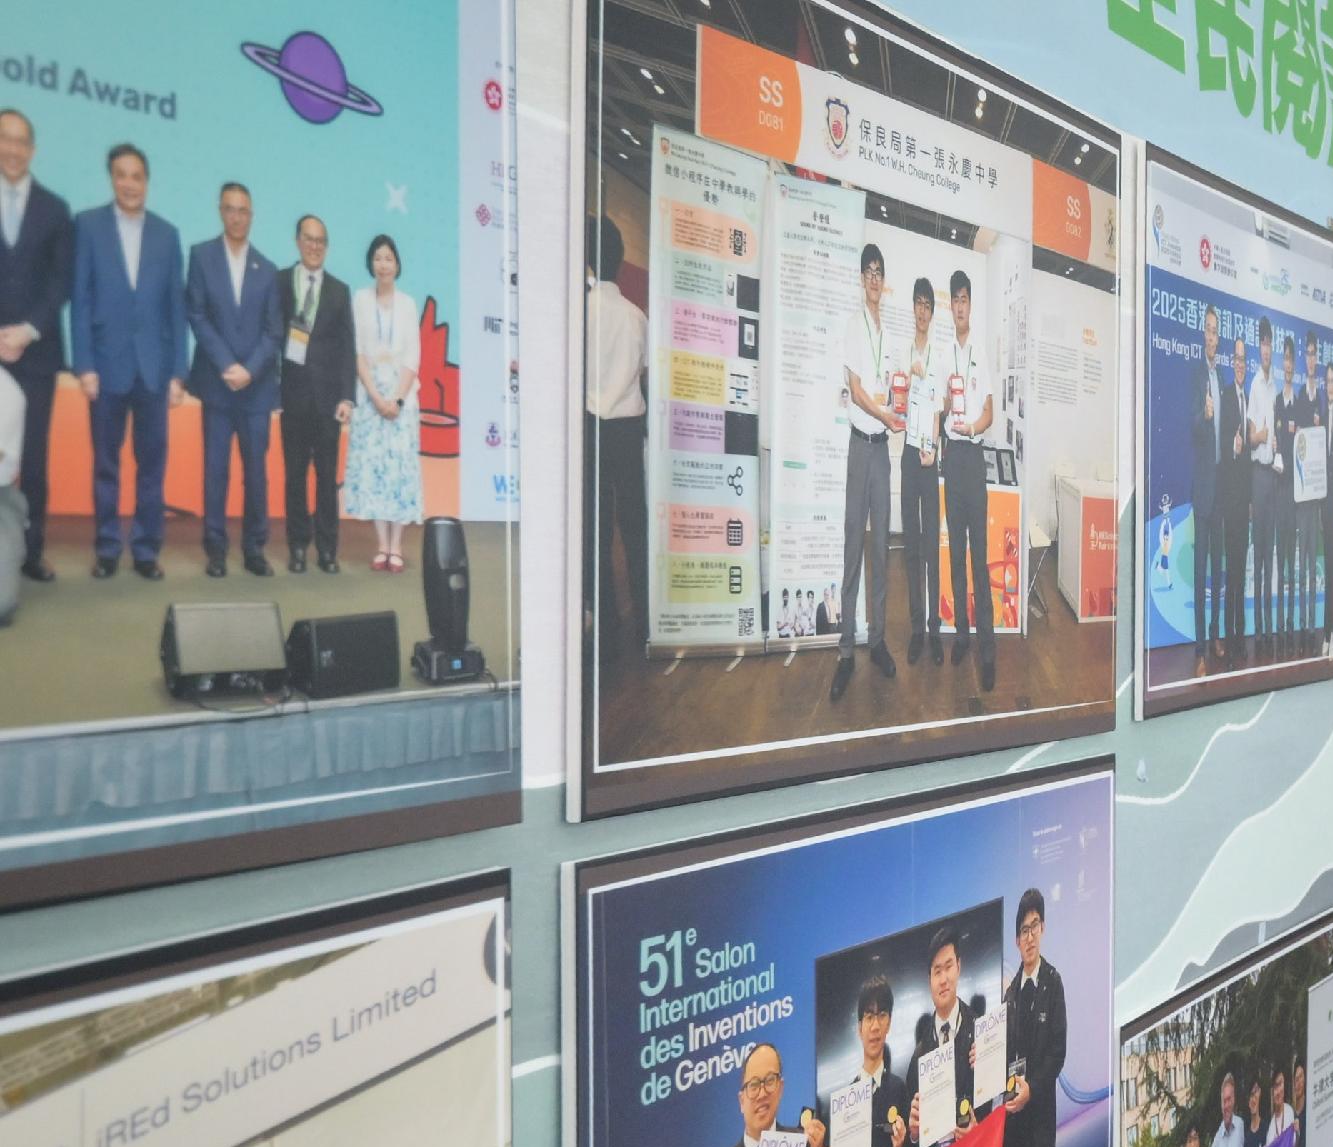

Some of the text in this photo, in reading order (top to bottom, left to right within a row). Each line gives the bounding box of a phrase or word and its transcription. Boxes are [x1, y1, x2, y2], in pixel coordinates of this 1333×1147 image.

[0, 54, 177, 121] old Award
[759, 75, 784, 108] SS
[859, 119, 998, 189] 保良局第一張永慶中學
[859, 145, 873, 162] PLK
[908, 163, 935, 187] Cheung
[936, 173, 961, 194] College
[1066, 195, 1082, 221] SS
[1152, 332, 1171, 356] Hong
[1172, 337, 1190, 361] Kong
[1191, 343, 1203, 360] ICT
[695, 941, 756, 979] Salon
[640, 962, 775, 1034] International
[181, 1031, 321, 1114] Solutions
[332, 969, 438, 1043] Limited
[640, 995, 794, 1069] des Inventions
[919, 1046, 953, 1077] DIPLÔME
[640, 1072, 682, 1106] de
[831, 1083, 871, 1115] DIPLÔME
